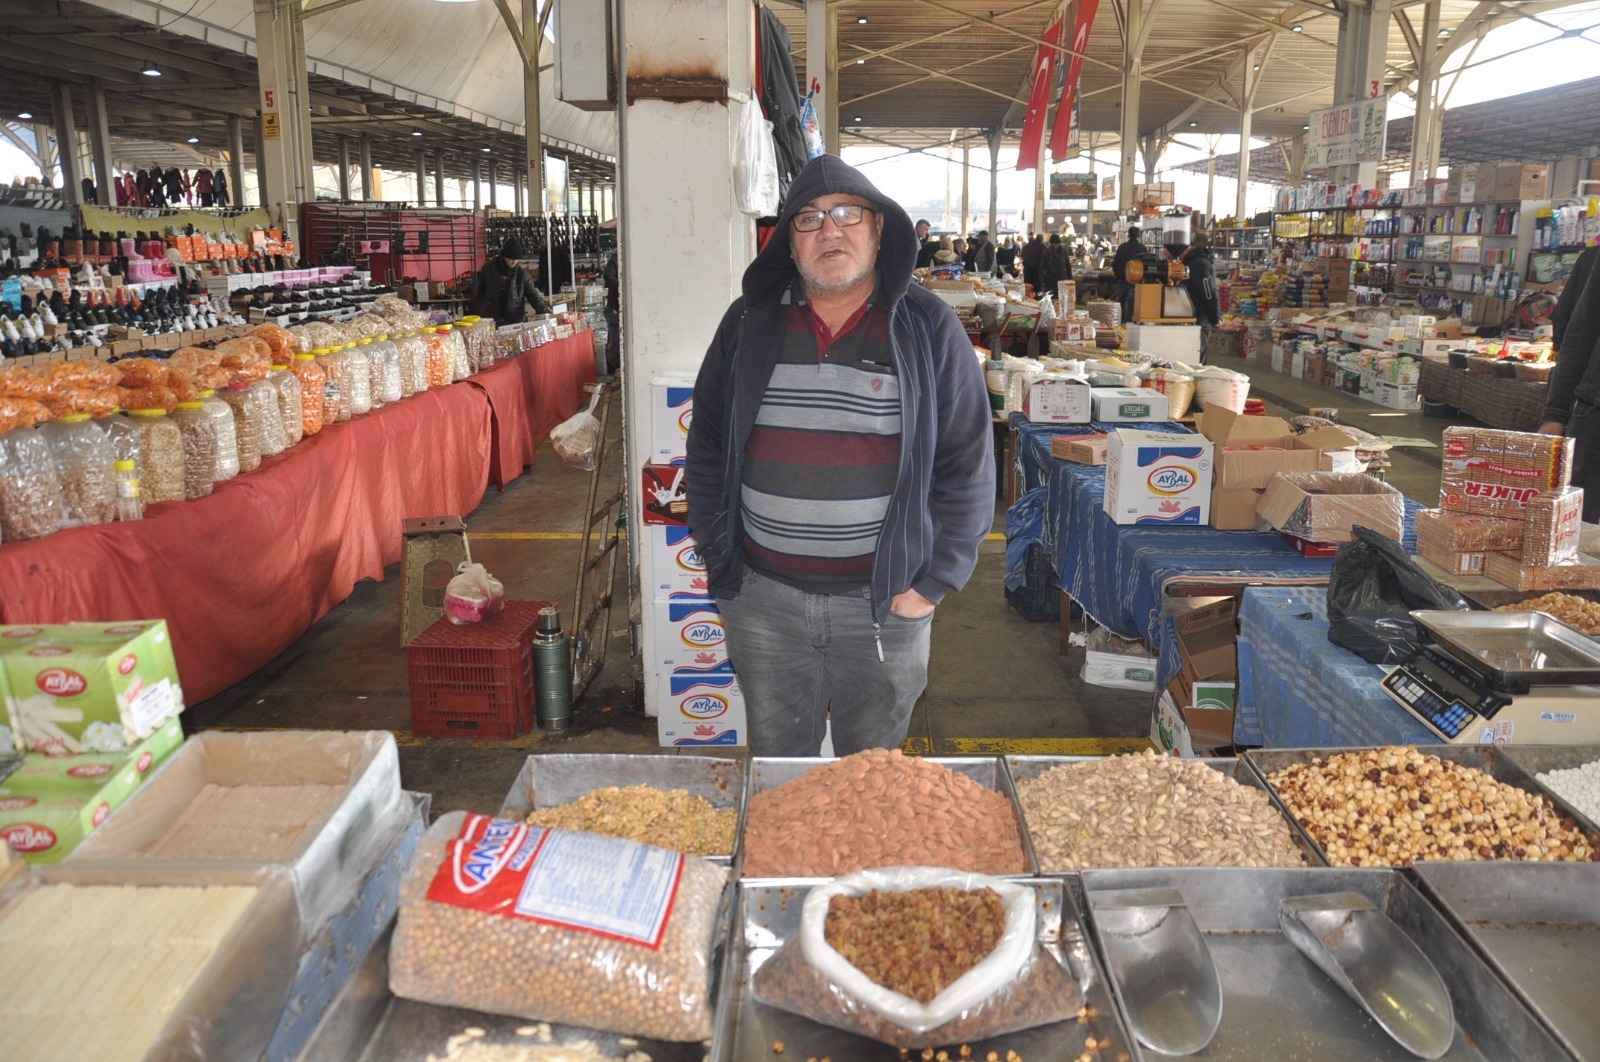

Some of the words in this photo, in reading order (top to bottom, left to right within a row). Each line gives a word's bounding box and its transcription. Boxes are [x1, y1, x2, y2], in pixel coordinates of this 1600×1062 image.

[1370, 80, 1379, 97] 3
[264, 90, 274, 108] 5
[1125, 157, 1131, 166] 3
[1417, 161, 1424, 171] 2
[1157, 471, 1189, 487] AYBAL
[691, 625, 723, 641] AYBAL
[692, 698, 724, 713] AYBAL
